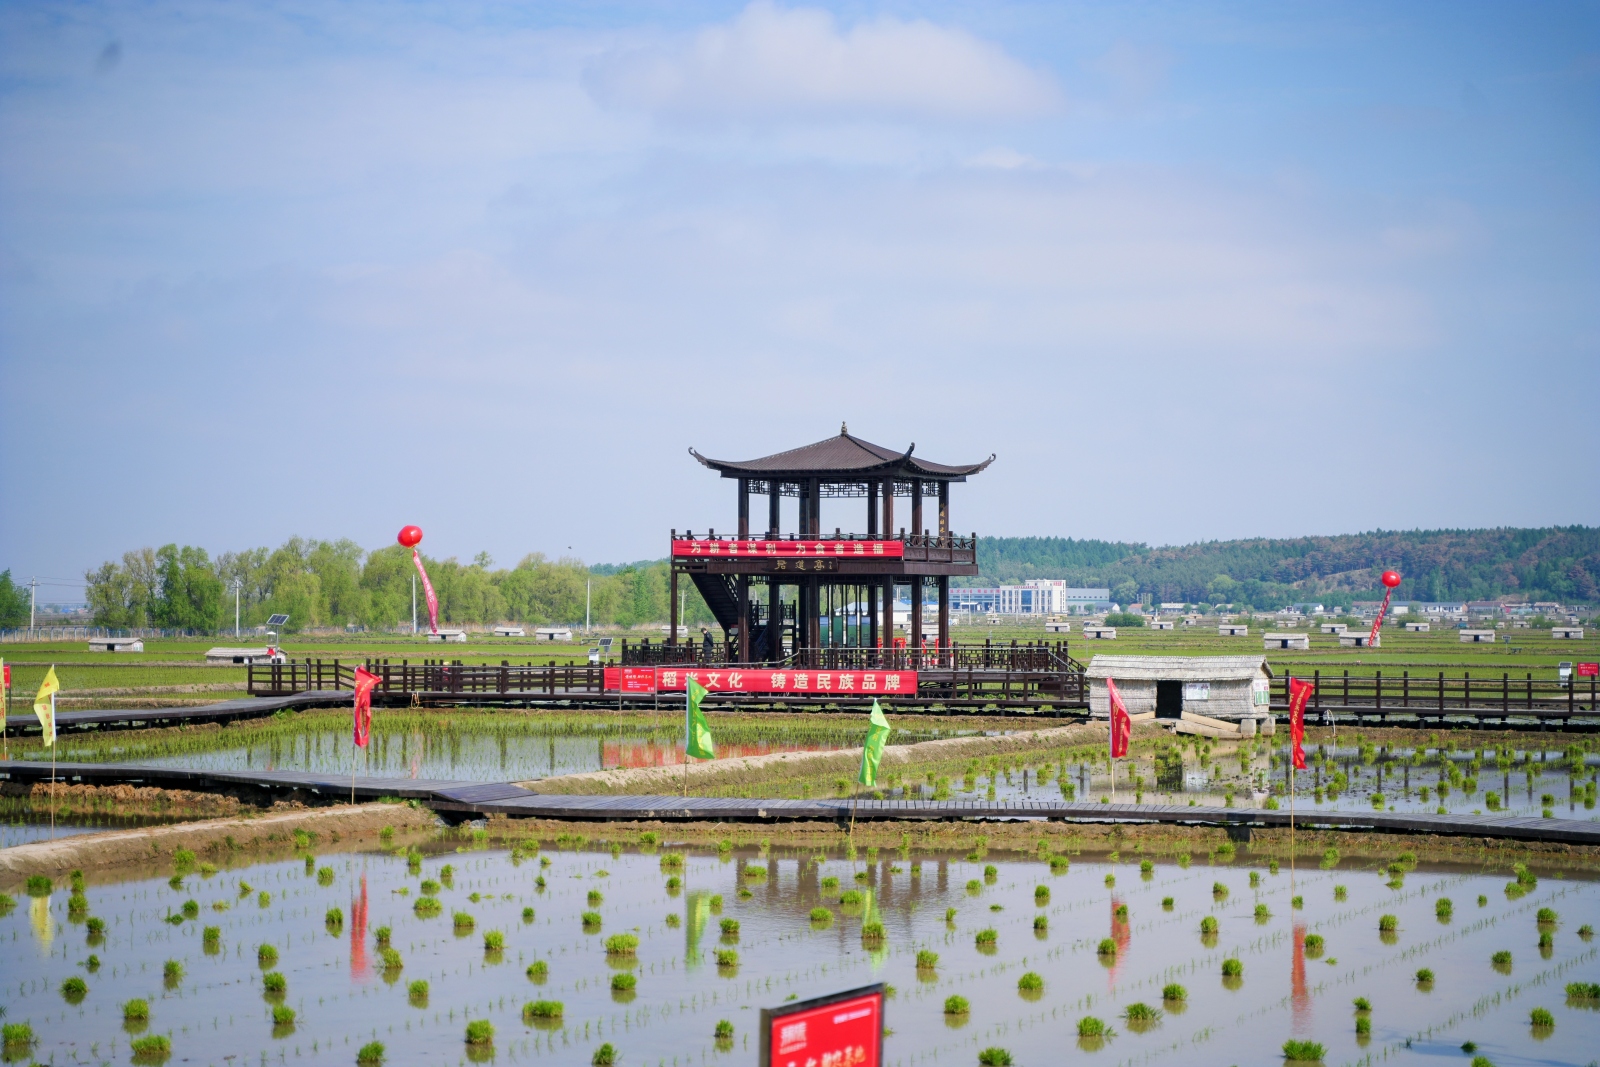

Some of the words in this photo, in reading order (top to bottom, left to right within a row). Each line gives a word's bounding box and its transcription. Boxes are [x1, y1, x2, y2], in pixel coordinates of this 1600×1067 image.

[690, 542, 777, 555] 为耕者谋利
[795, 542, 884, 555] 为食者造福
[771, 672, 901, 691] 铸造民族品牌
